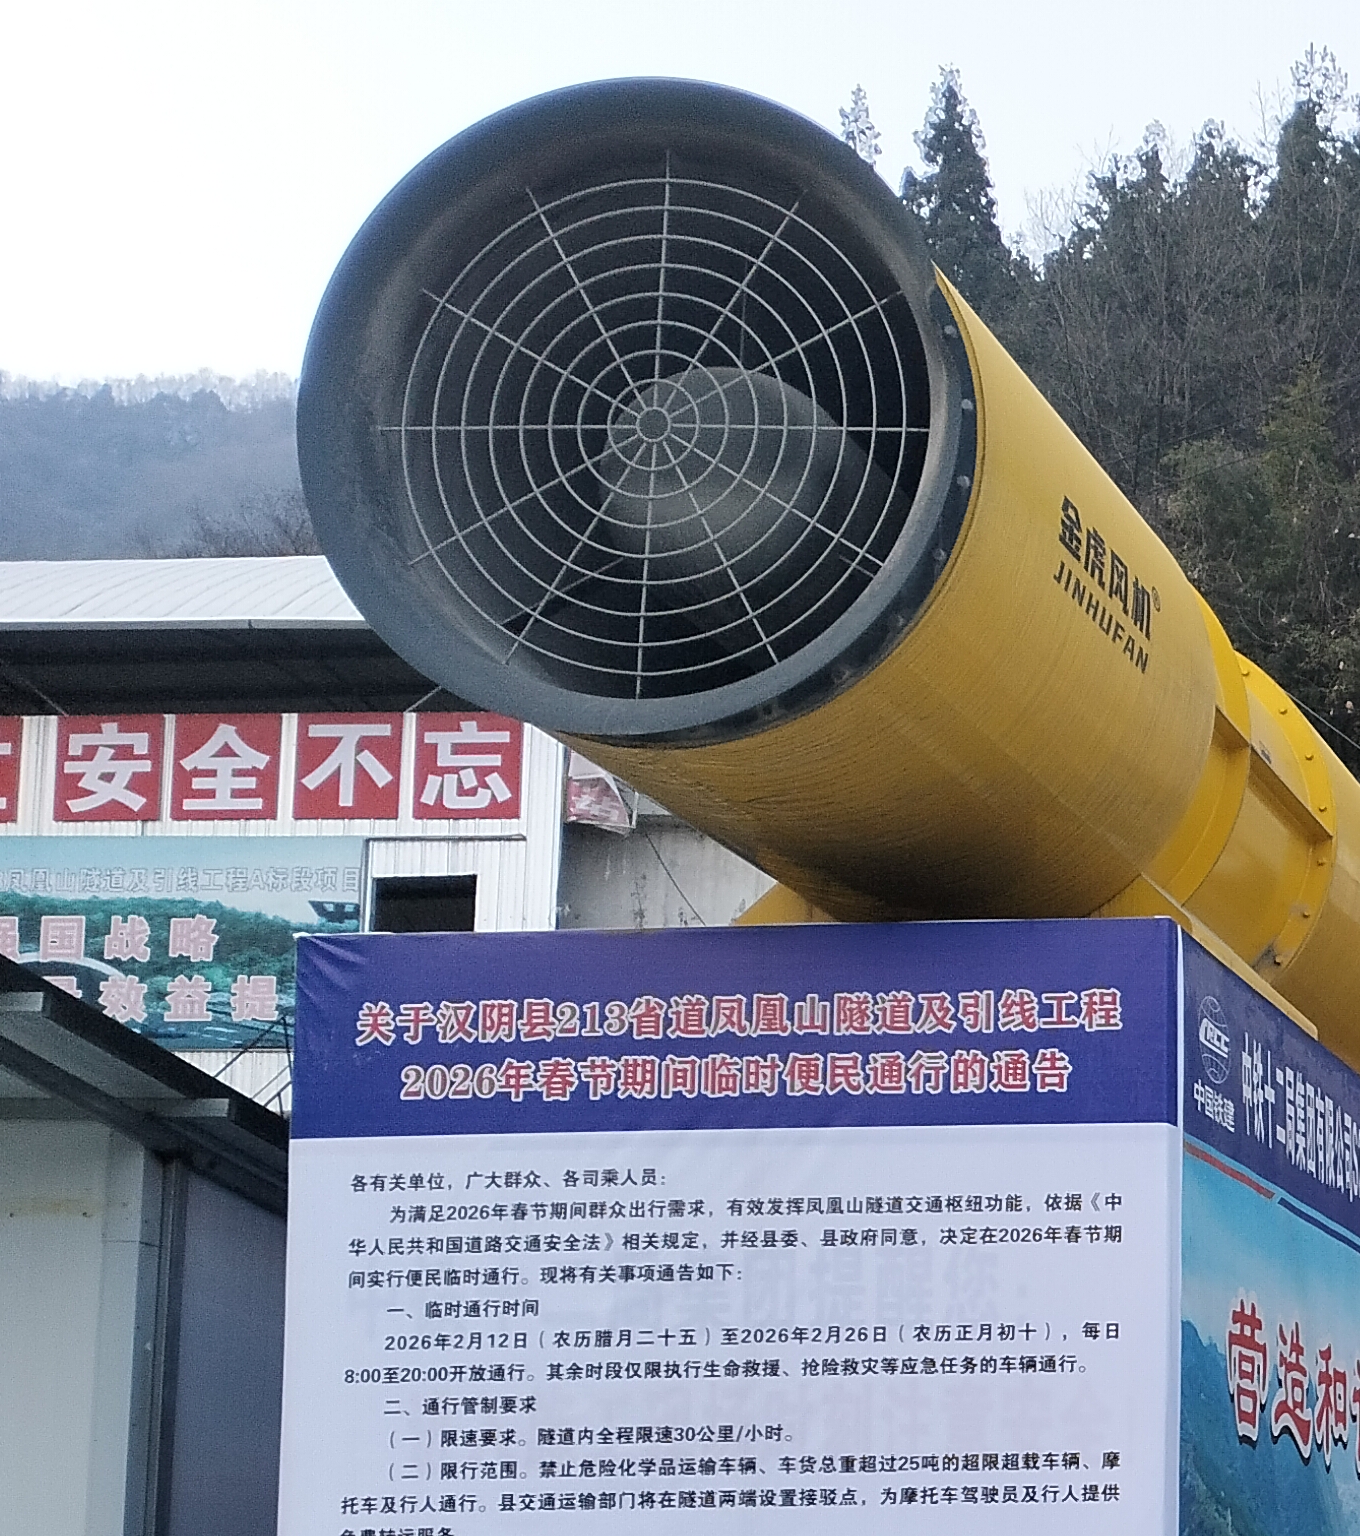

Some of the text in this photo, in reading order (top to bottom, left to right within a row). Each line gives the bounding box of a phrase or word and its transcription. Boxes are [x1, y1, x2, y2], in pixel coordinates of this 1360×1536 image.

[1059, 495, 1150, 641] 金虎风机
[1053, 560, 1149, 674] JINHUFAN
[0, 721, 512, 813] 安全不忘
[0, 866, 361, 894] 凤凰山隧道及引线工程A标段项目
[355, 988, 1122, 1046] 关于汉阴县213省道凤凰山隧道及引线工程
[400, 1049, 1073, 1101] 2026年春节期间临时便民通行的通告
[1194, 1079, 1235, 1133] 中国铁建
[350, 1168, 666, 1193] 各有关单位，广大群众、各司乘人员：
[389, 1192, 1122, 1224] 为满足2026年春节期间群众出行需求，有效发挥凤凰山隧道交通枢纽功能，依据《中
[348, 1224, 1122, 1257] 华人民共和国道路交通安全法》相关规定，并经县委、县政府同意，决定在2026年春节期
[348, 1262, 742, 1289] 间实行便民临时通行。现将有关事项通告如下：
[386, 1298, 539, 1320] 一、临时通行时间
[383, 1395, 537, 1416] 二、通行管制要求
[390, 1423, 793, 1449] （一）限速要求。隧道内全程限速30公里/小时。
[340, 1483, 1120, 1515] 托车及行人通行。县交通运输部门将在隧道两端设置接驳点，为摩托车驾驶员及行人提供
